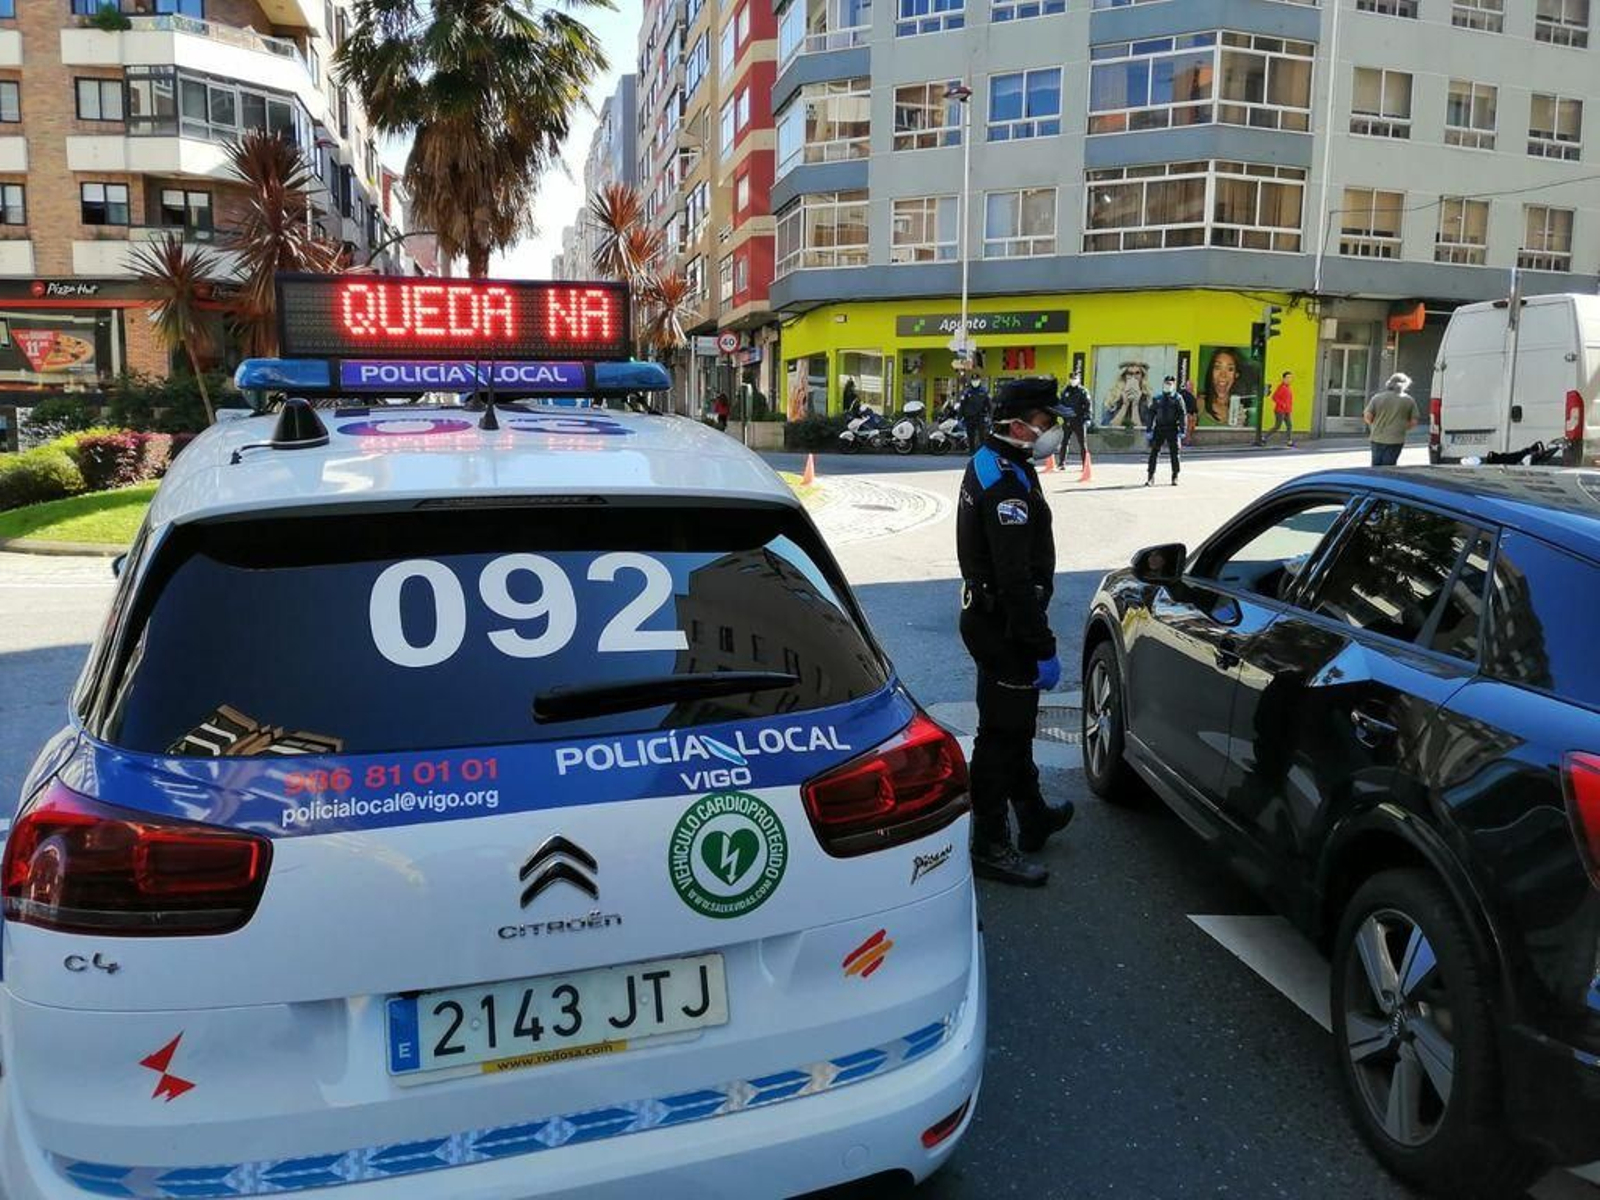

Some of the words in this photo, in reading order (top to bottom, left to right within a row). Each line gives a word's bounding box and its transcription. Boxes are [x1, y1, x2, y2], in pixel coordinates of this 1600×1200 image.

[47, 282, 75, 295] Pizza
[77, 283, 98, 295] Hut
[341, 283, 513, 336] QUEDA
[547, 288, 610, 338] NA
[992, 315, 1020, 329] 24h
[722, 338, 735, 347] 40
[361, 363, 466, 382] POLICÍA
[487, 366, 567, 382] LOCAL
[369, 551, 689, 668] 092
[555, 731, 710, 775] POLICÍA
[735, 726, 852, 755] LOCAL
[365, 764, 401, 788] 81
[412, 760, 450, 785] 01
[461, 758, 498, 782] 01
[680, 767, 752, 791] VIGO
[282, 790, 499, 827] policialocal@vigo.org
[673, 814, 701, 890] VEHICULO
[696, 795, 784, 880] CARDIOPROTEGIDO
[432, 984, 583, 1058] 2143
[608, 965, 711, 1029] JTJ
[399, 1040, 411, 1059] E
[496, 1041, 613, 1071] www.rodosa.com
